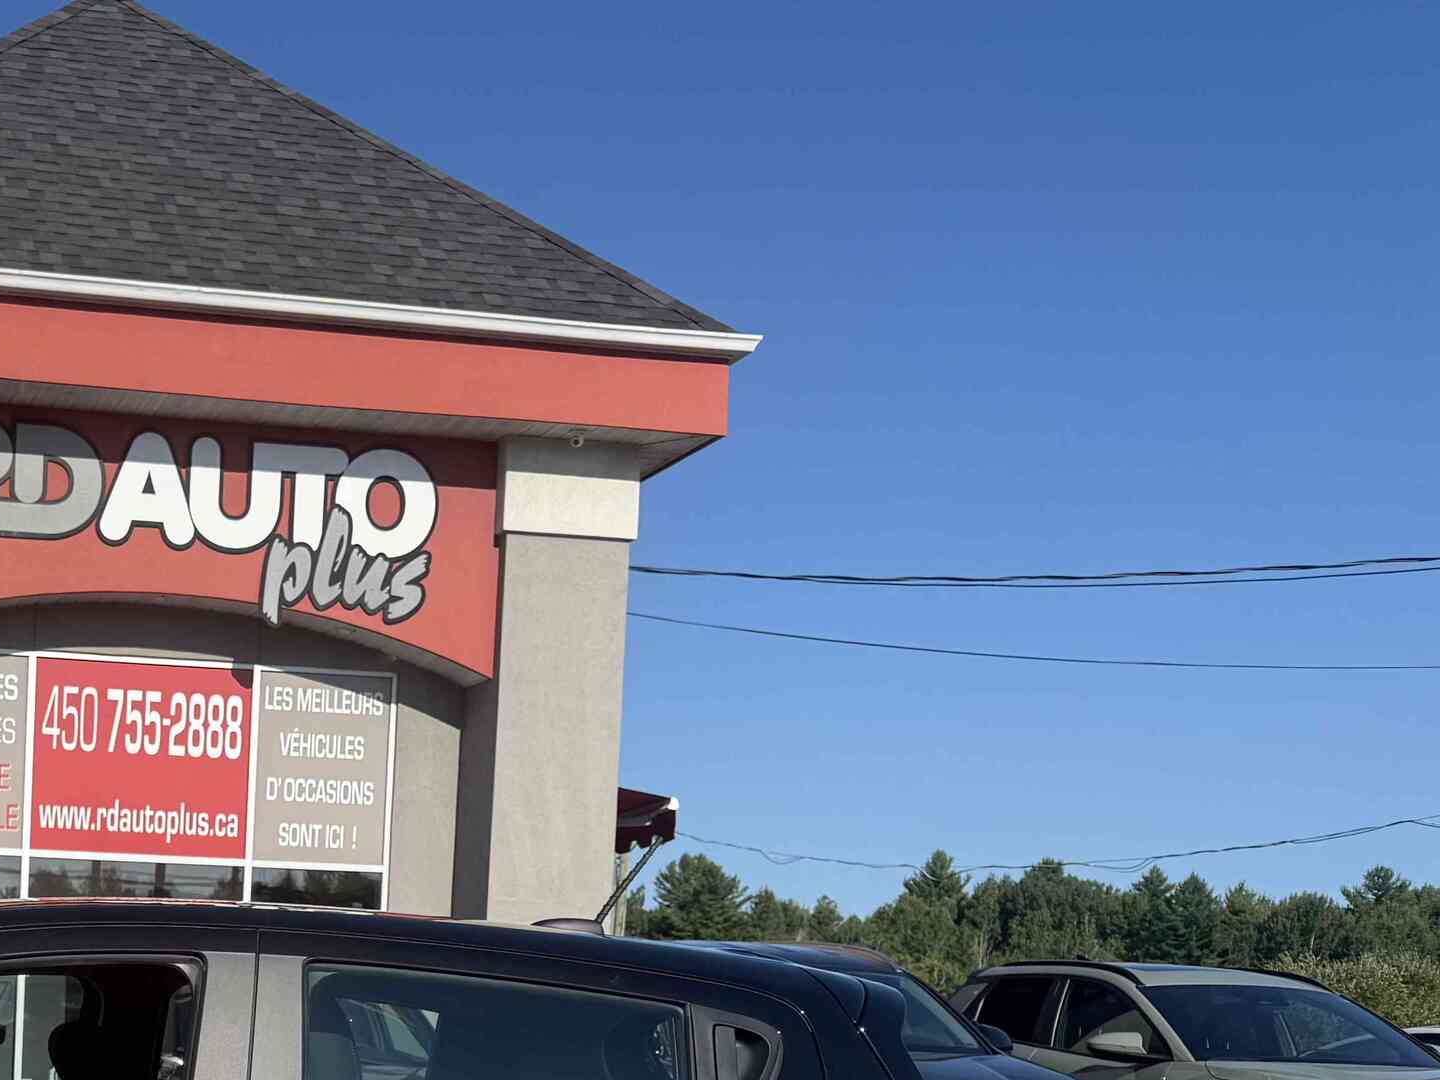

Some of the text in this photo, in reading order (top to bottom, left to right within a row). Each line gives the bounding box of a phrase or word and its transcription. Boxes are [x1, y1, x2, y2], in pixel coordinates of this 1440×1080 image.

[261, 506, 430, 625] plus
[265, 685, 382, 715] LES MEILLEURS
[41, 685, 244, 759] 450 755-2888
[279, 728, 364, 760] VÉHICULES
[39, 800, 239, 843] www.rdautoplus.ca
[278, 823, 321, 849] SONT
[325, 824, 345, 849] ICI
